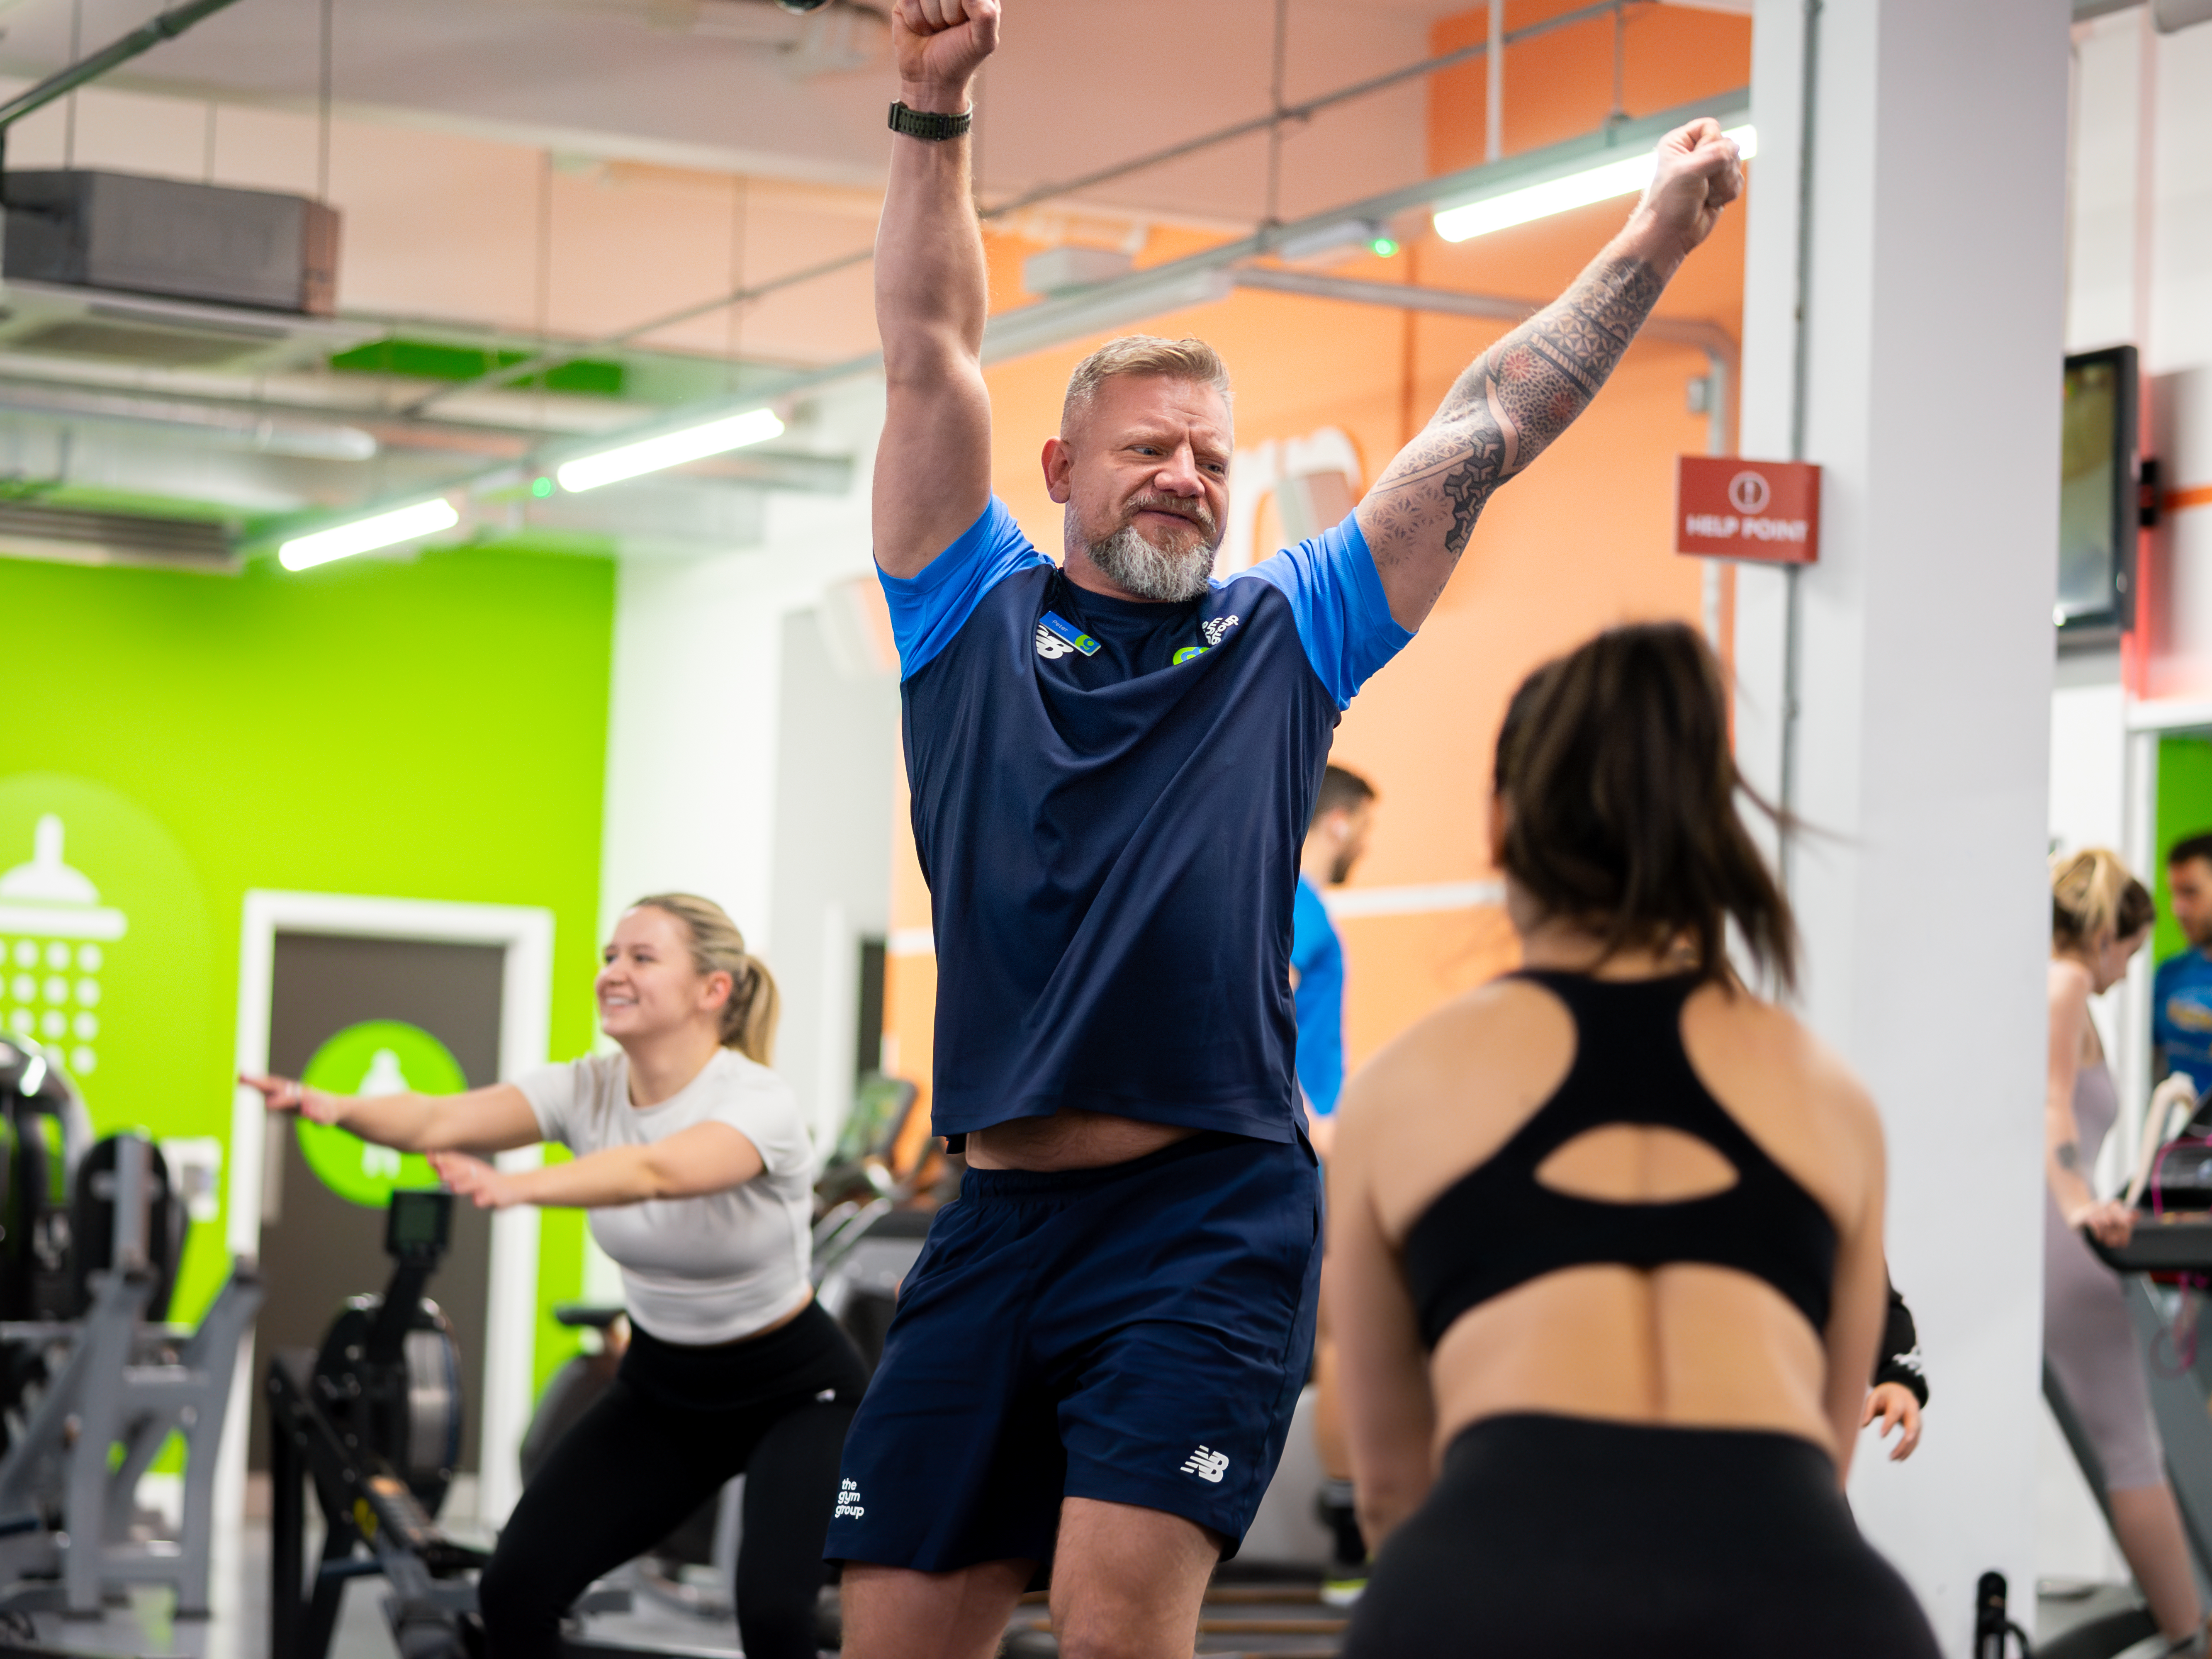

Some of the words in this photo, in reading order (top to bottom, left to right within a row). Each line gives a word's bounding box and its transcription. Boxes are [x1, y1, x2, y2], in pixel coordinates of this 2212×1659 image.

[1685, 513, 1739, 538] HELP
[1741, 516, 1808, 542] POINT
[1051, 620, 1069, 632] Peter
[1211, 615, 1239, 645] group
[842, 1478, 857, 1490] the
[837, 1491, 860, 1504] gym
[835, 1505, 864, 1519] group
